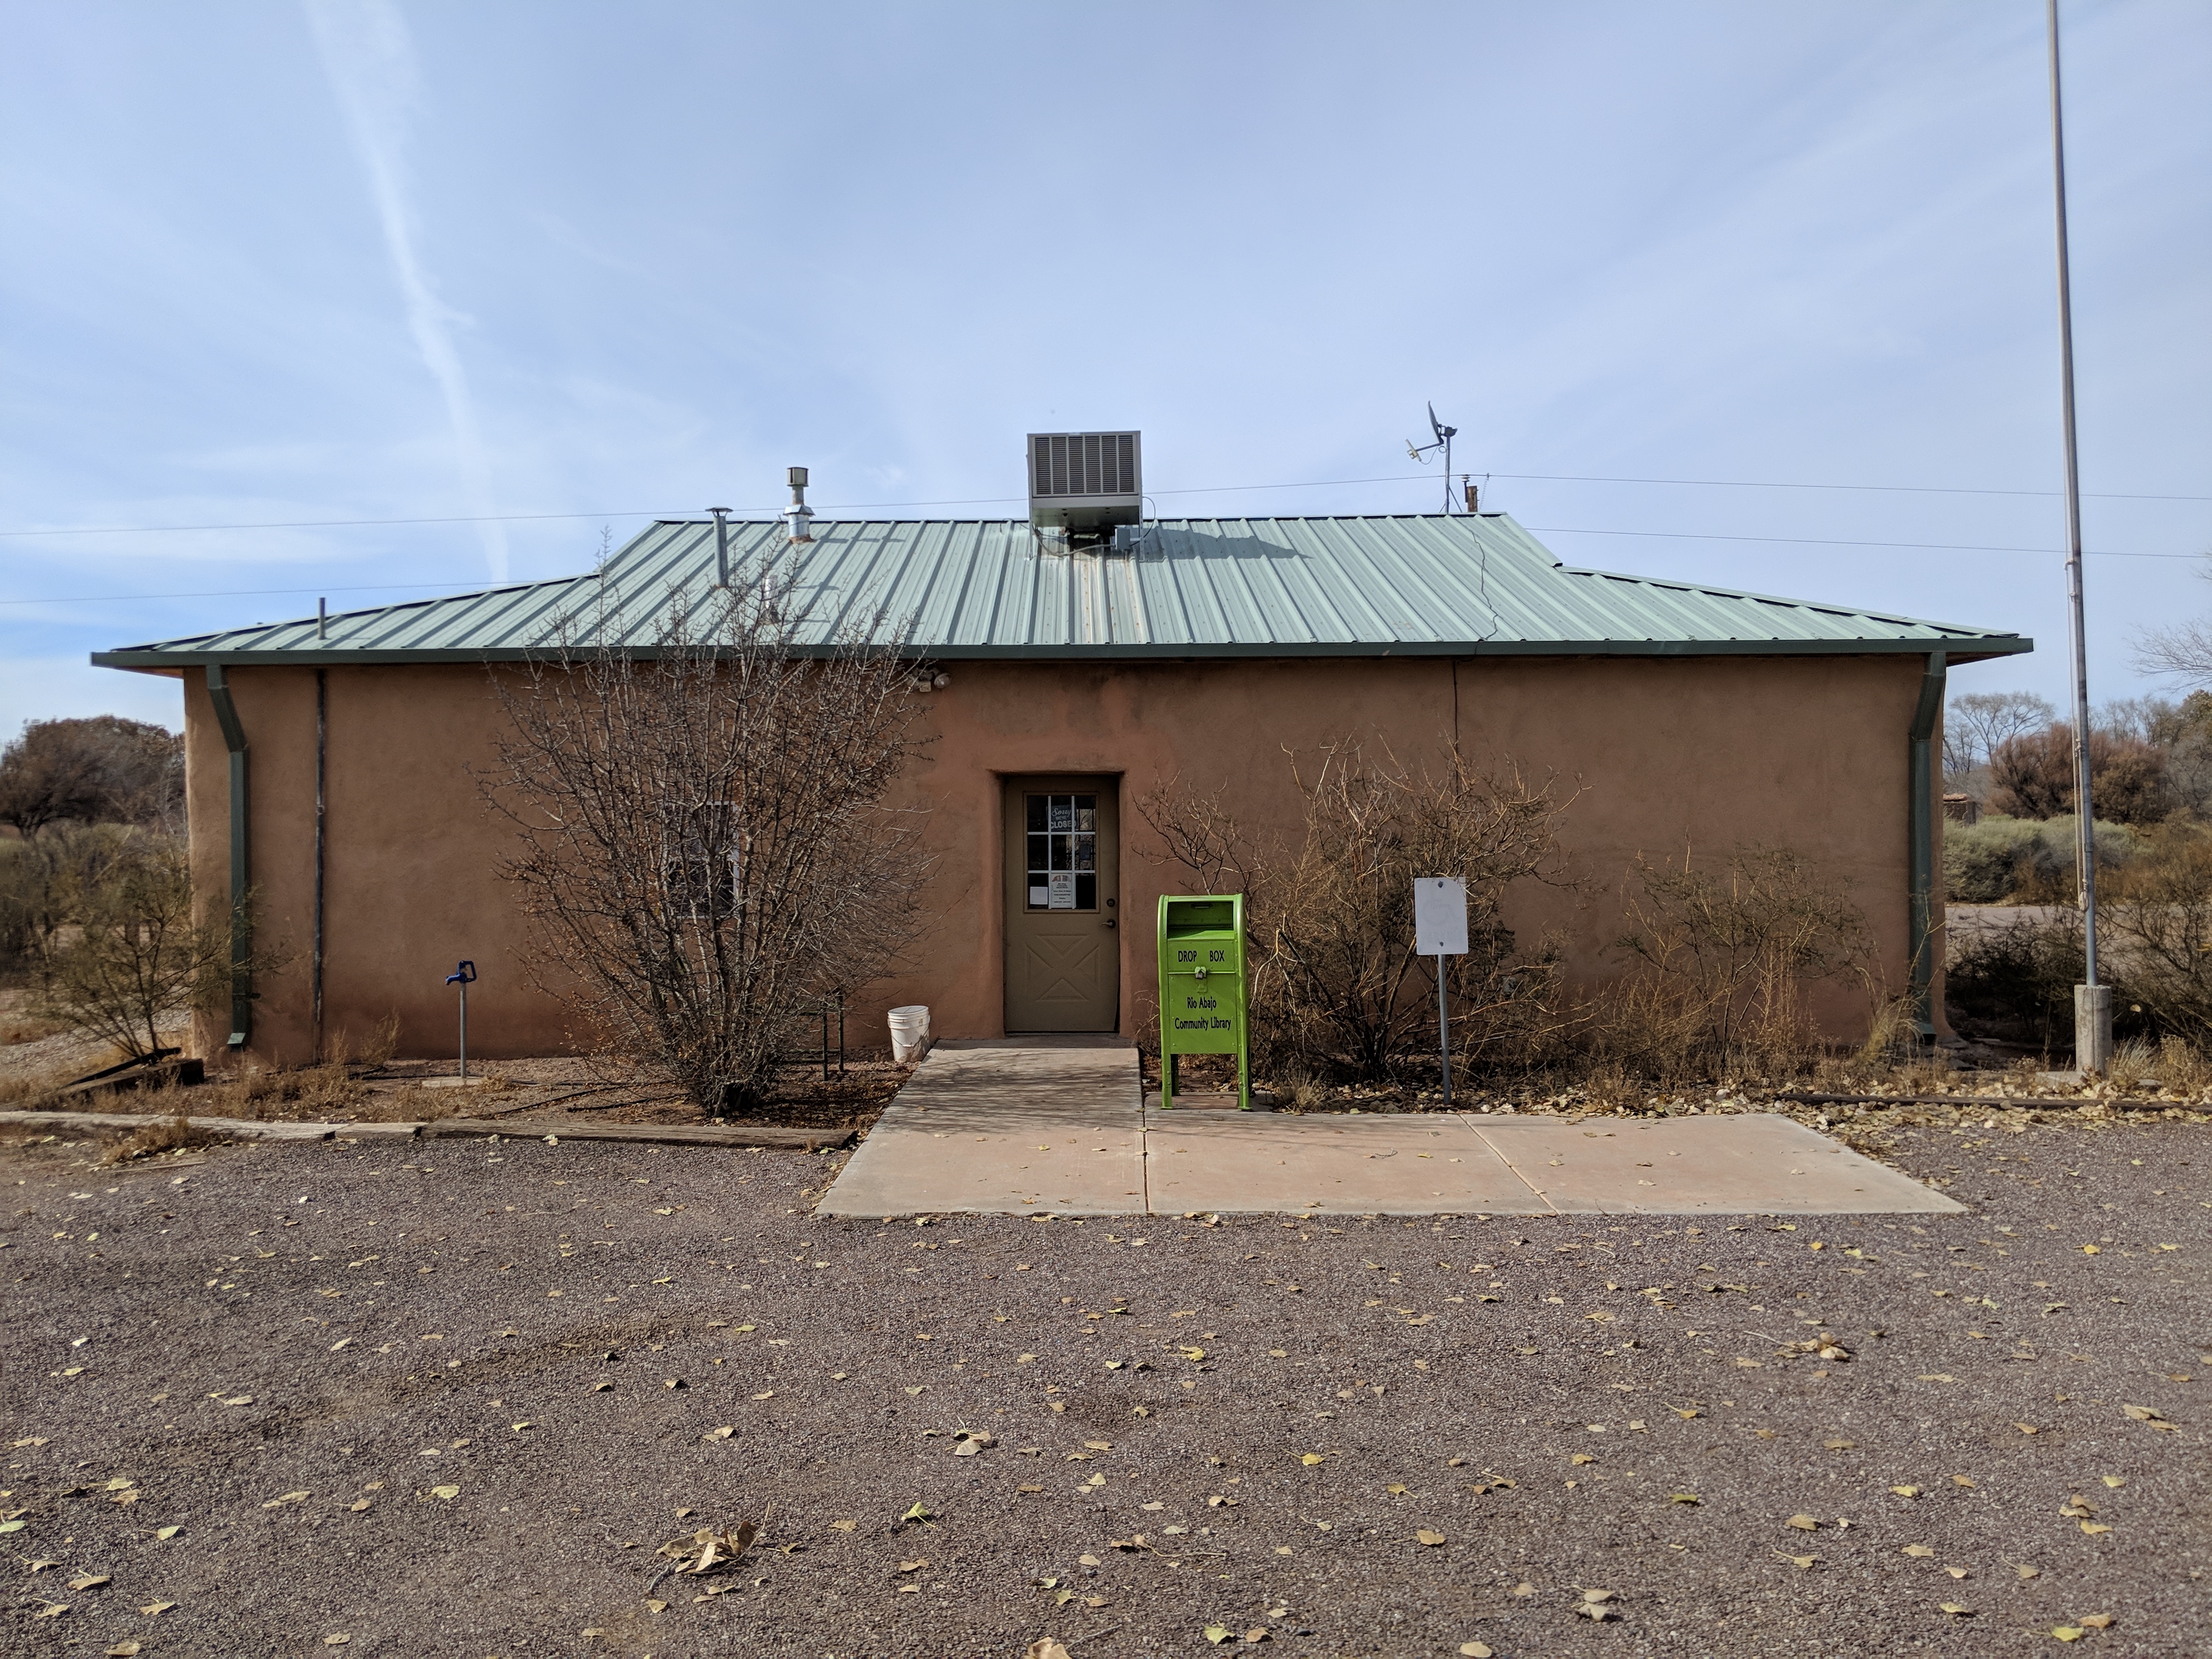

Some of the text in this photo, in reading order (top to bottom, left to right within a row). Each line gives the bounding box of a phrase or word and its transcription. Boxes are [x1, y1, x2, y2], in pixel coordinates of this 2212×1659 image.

[1052, 808, 1071, 818] Sorry
[1178, 950, 1225, 962] DROP BOX
[1187, 996, 1217, 1011] Rio Abajo
[1175, 1016, 1232, 1031] Community Library
